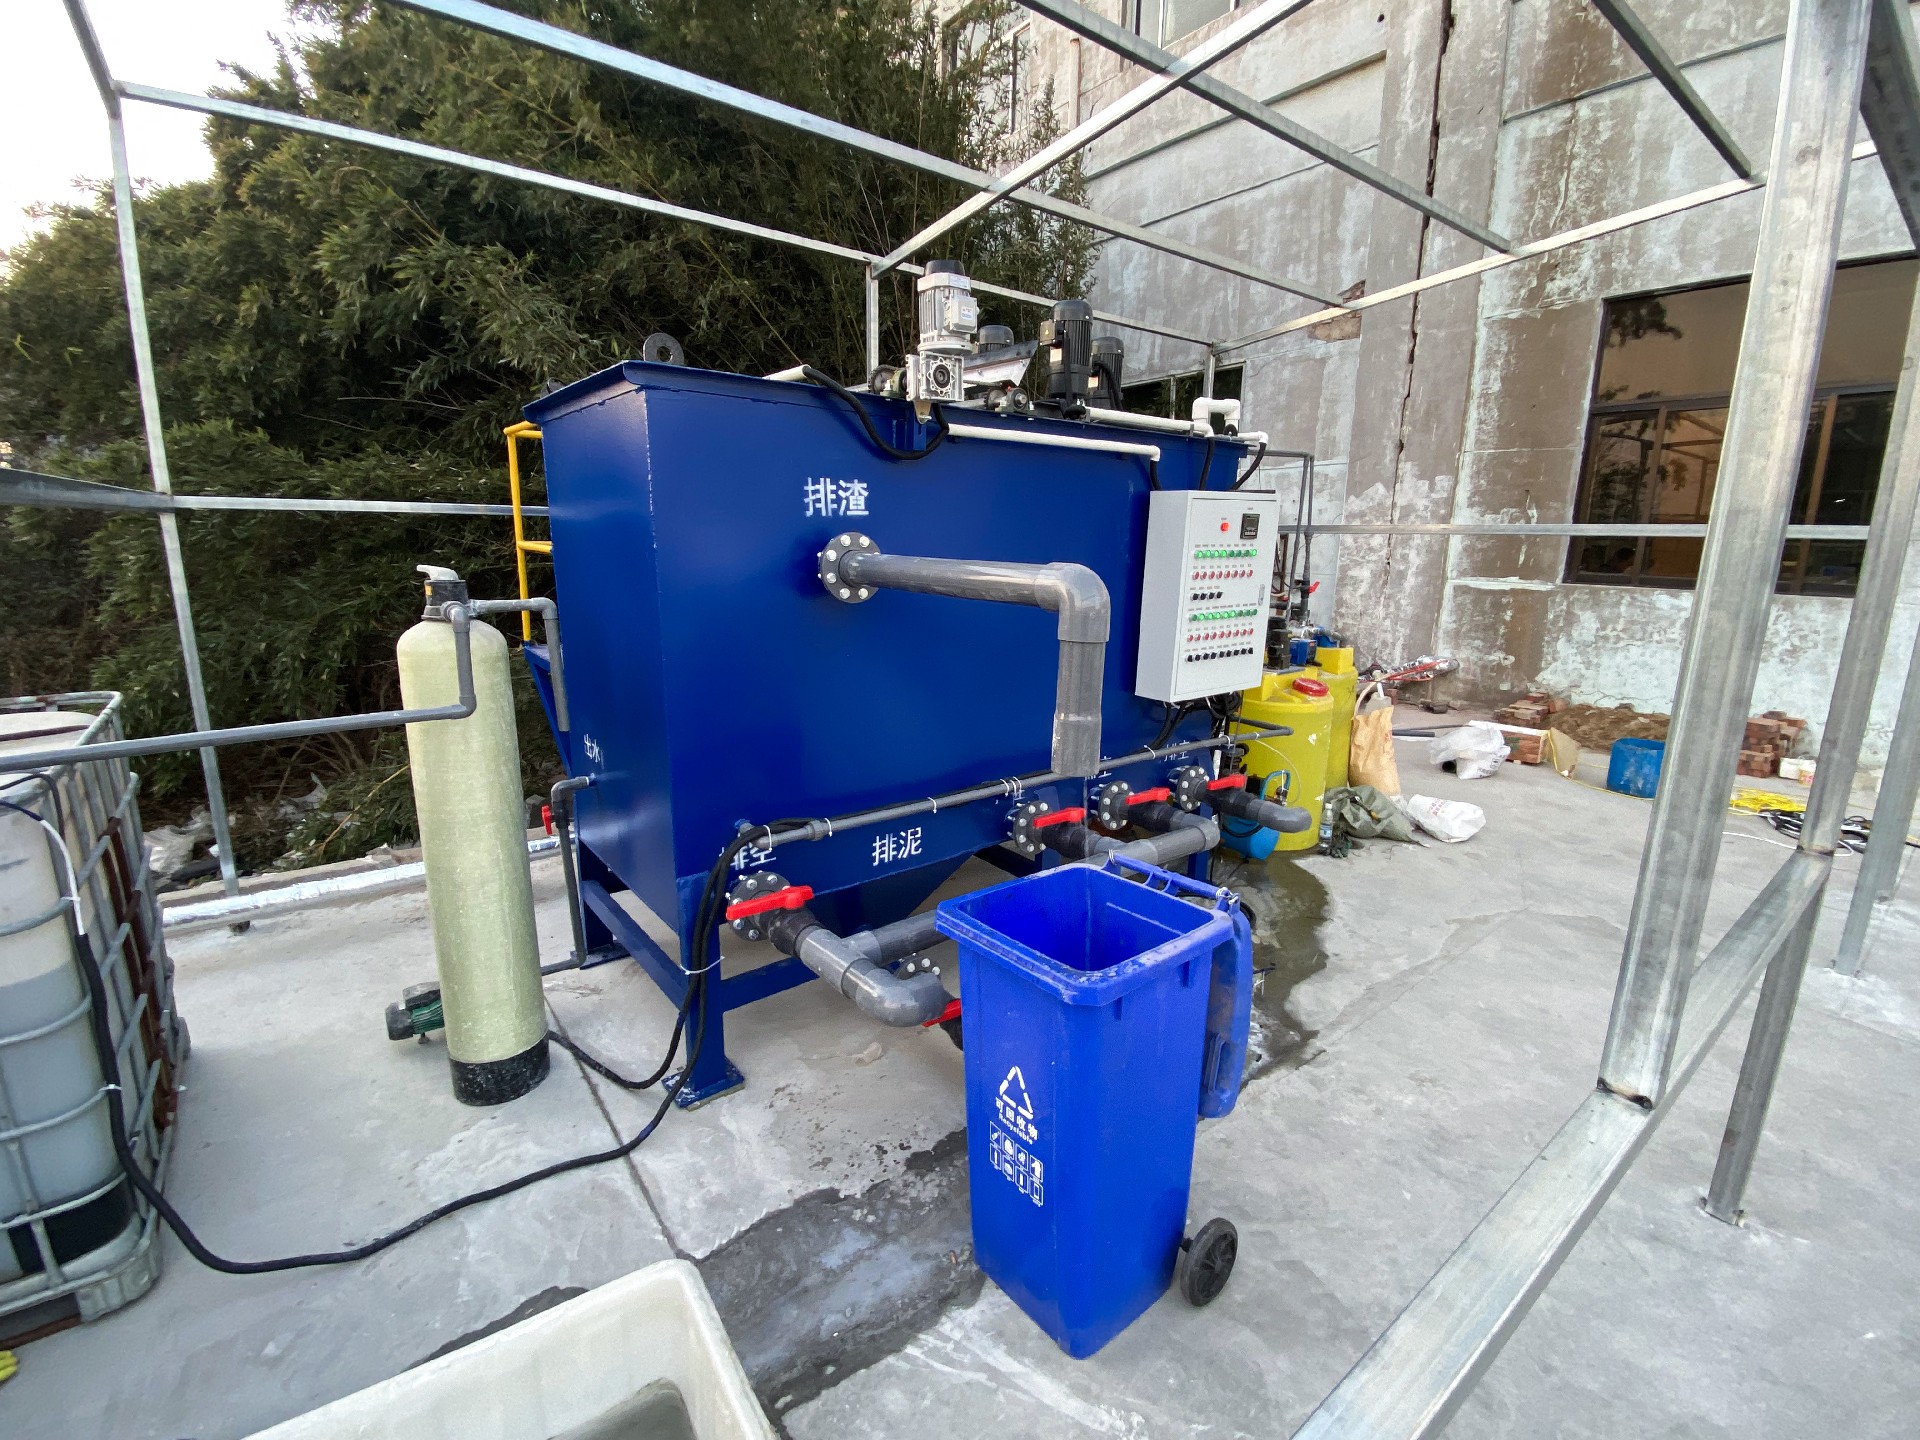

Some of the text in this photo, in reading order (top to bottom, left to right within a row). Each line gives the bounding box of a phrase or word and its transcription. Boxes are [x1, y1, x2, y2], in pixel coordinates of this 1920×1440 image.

[803, 477, 869, 517] 排渣
[584, 734, 600, 763] 出水
[872, 827, 922, 866] 排泥
[995, 1096, 1038, 1140] 可回收物
[998, 1112, 1033, 1145] Recyclable
